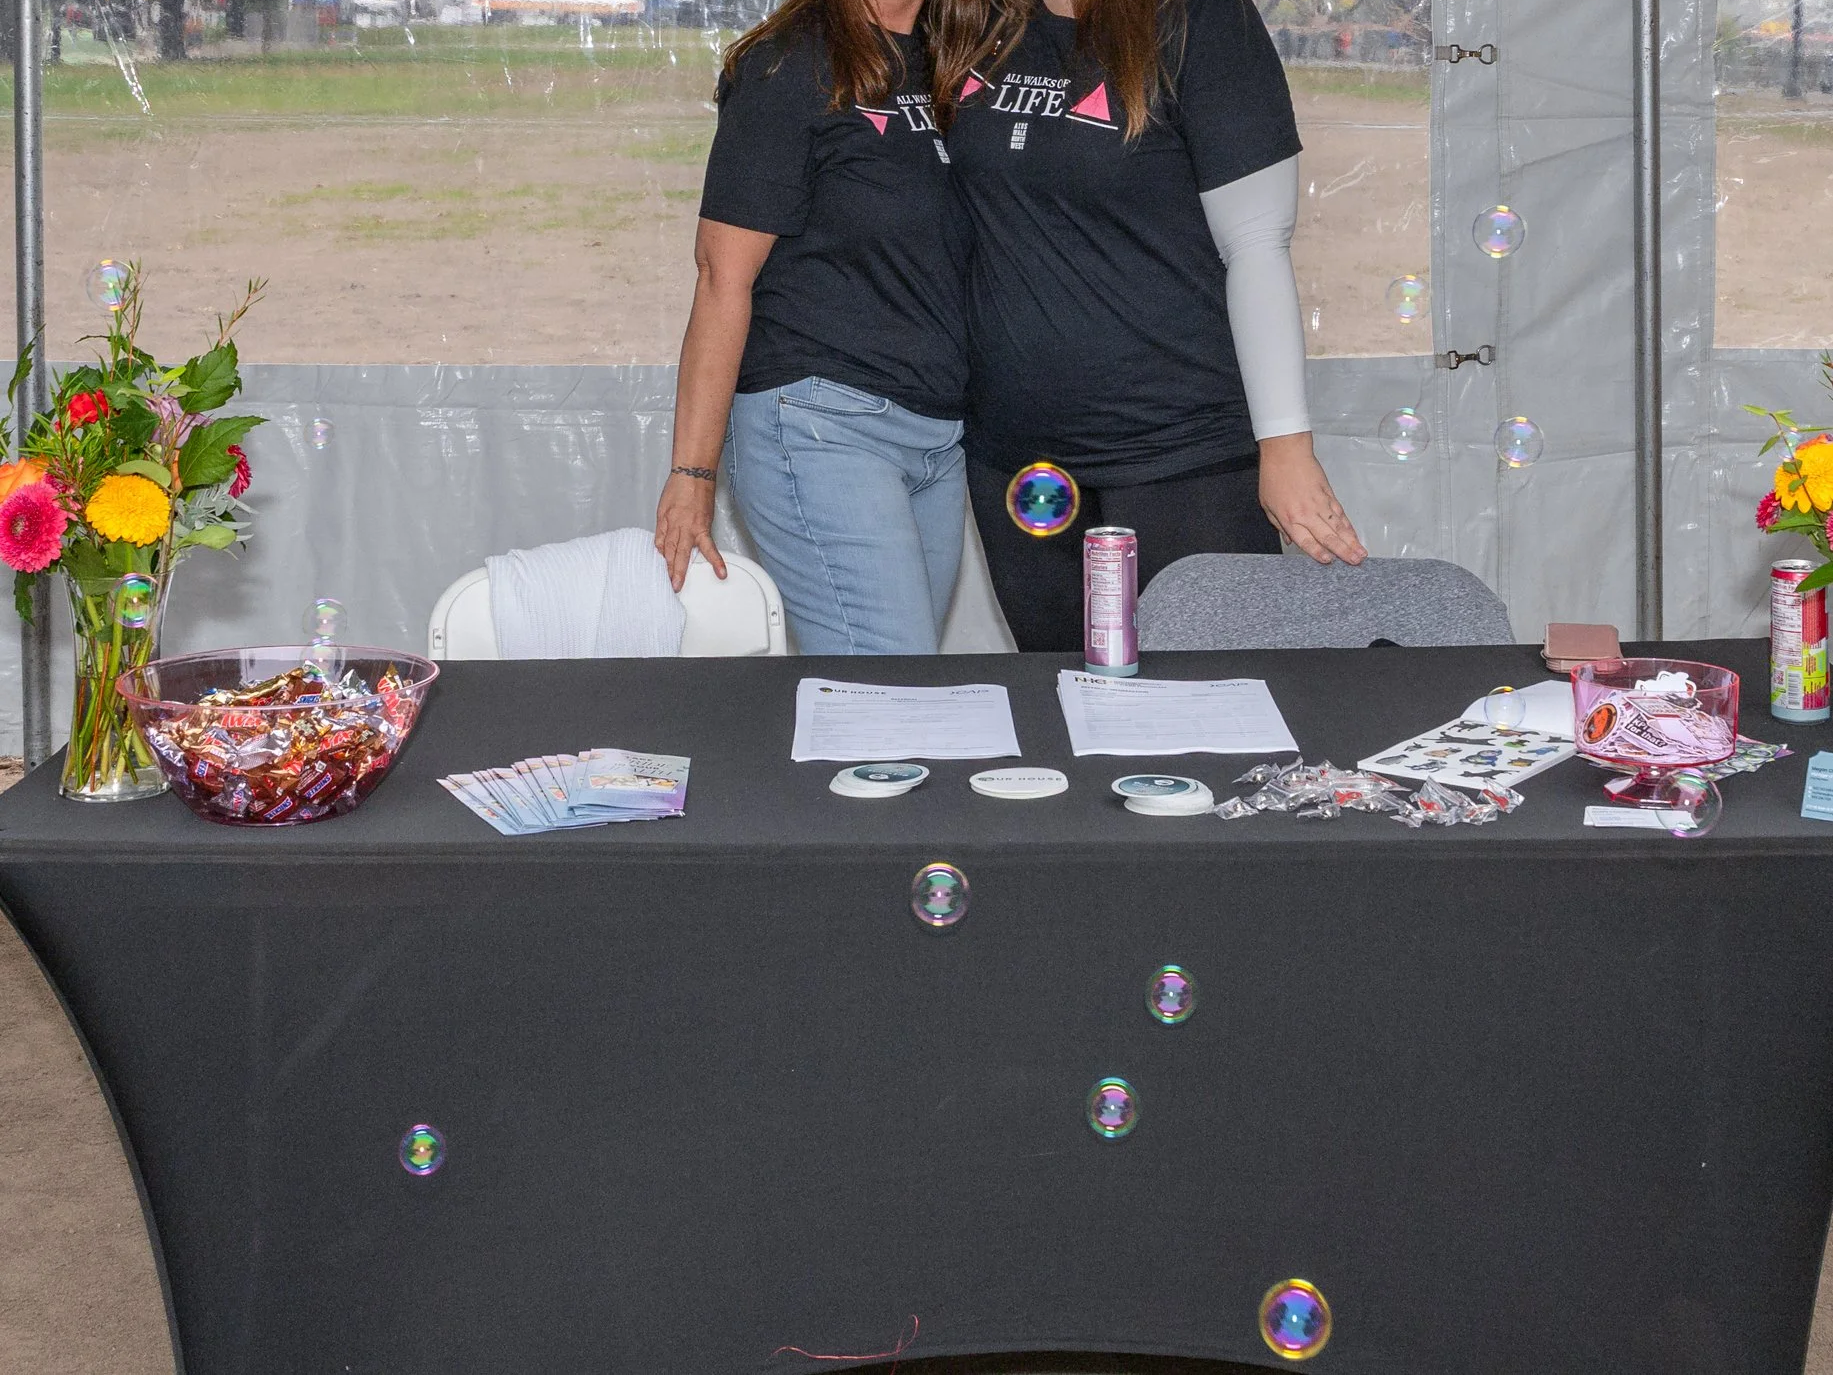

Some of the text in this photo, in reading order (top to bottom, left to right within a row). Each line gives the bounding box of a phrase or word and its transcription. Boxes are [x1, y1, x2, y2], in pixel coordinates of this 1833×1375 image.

[1003, 73, 1071, 89] ALL WALKS OF
[896, 94, 914, 105] ALL
[991, 84, 1066, 117] LIFE
[1014, 122, 1028, 130] AIDS
[1010, 142, 1025, 150] WEST
